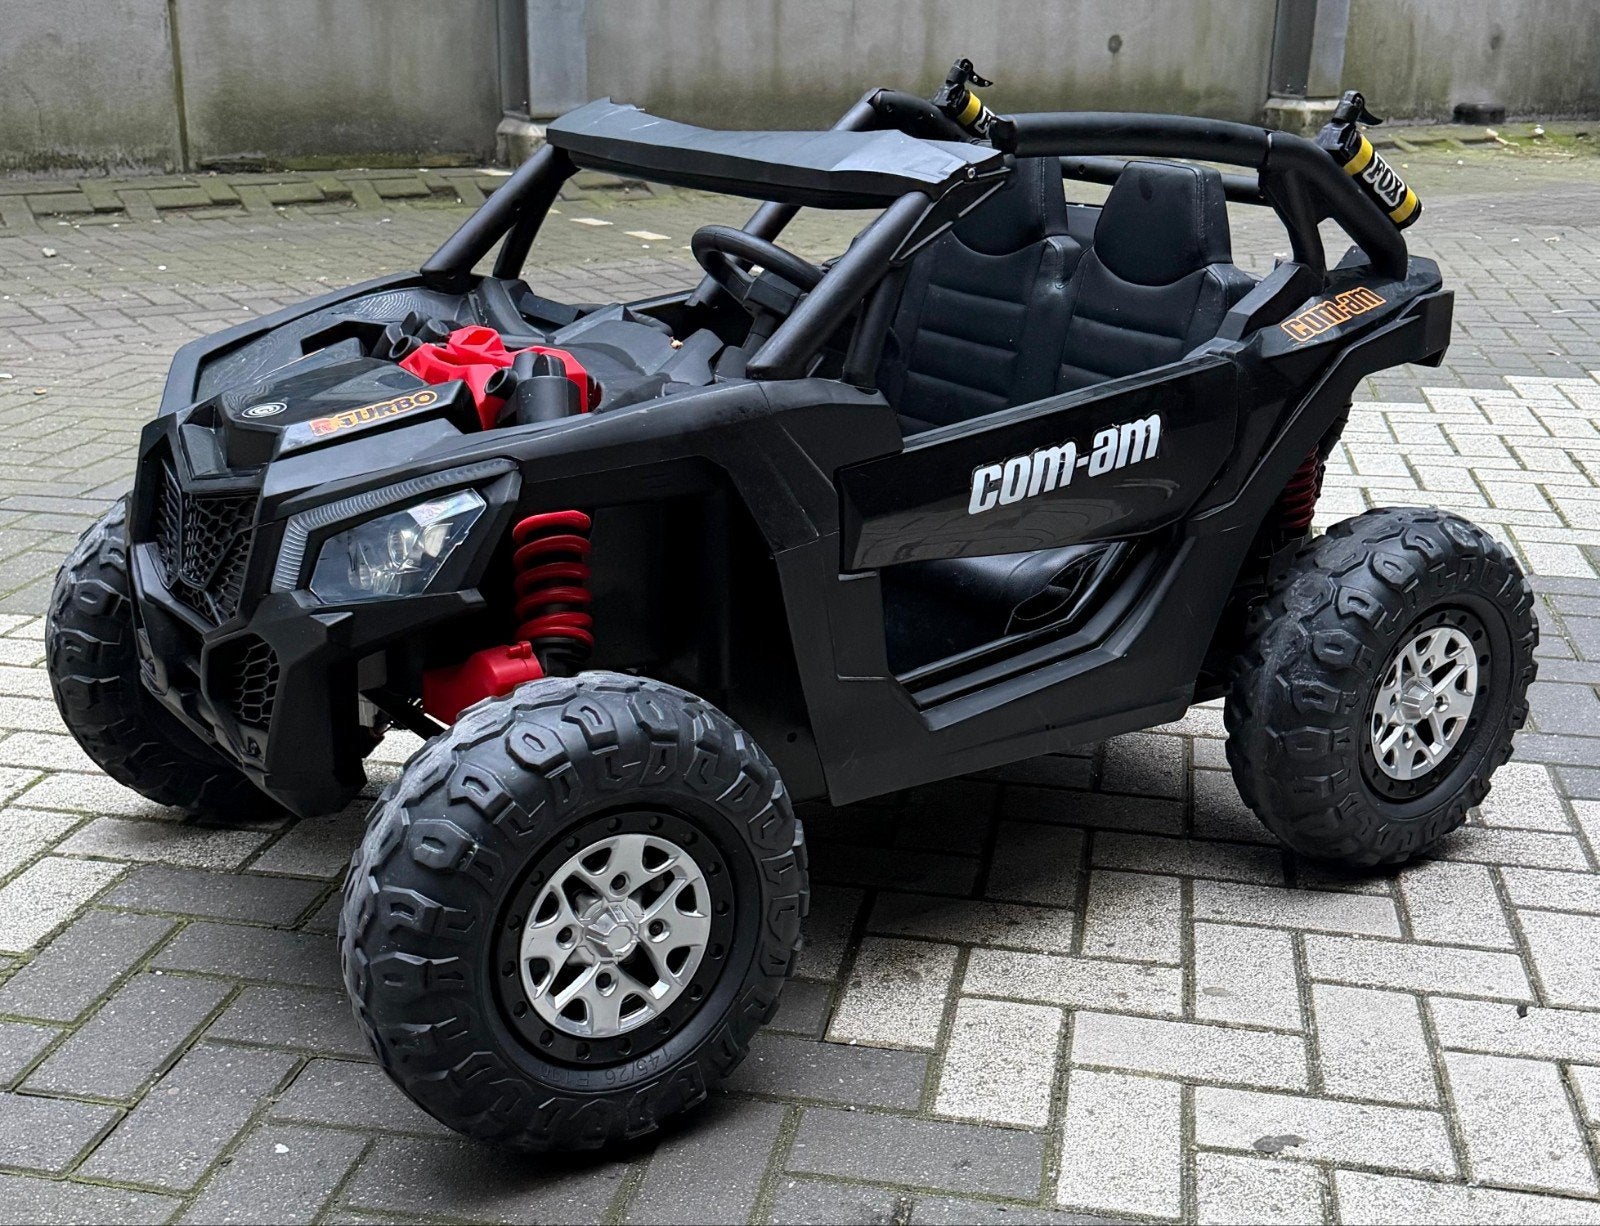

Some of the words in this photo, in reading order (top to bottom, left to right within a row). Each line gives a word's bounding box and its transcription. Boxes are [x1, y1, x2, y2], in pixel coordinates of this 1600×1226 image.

[1362, 151, 1406, 206] FOX
[335, 391, 438, 428] TURBO
[605, 1048, 671, 1085] 145/26
